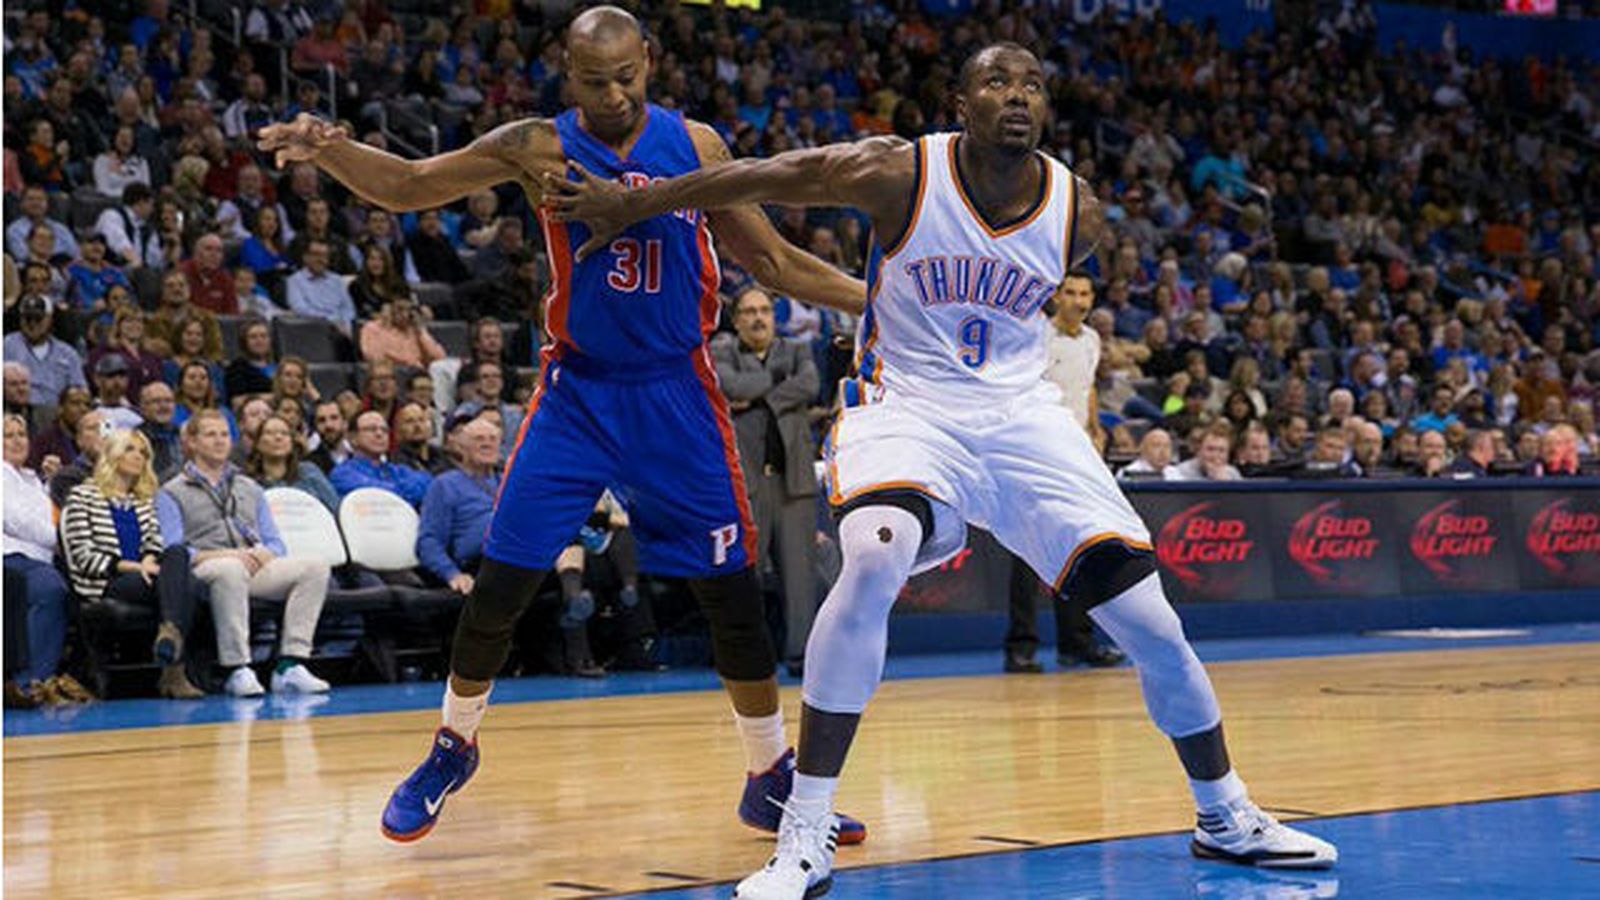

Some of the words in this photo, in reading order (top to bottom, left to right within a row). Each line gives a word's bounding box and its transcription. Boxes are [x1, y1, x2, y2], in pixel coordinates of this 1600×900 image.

[607, 237, 662, 293] 31
[957, 315, 991, 371] 9
[1185, 517, 1246, 540] BUD
[1315, 516, 1371, 537] BUD
[1436, 515, 1489, 534] BUD
[709, 523, 738, 565] P
[1173, 540, 1252, 562] LIGHT
[1303, 538, 1380, 559] LIGHT
[1423, 536, 1498, 557] LIGHT
